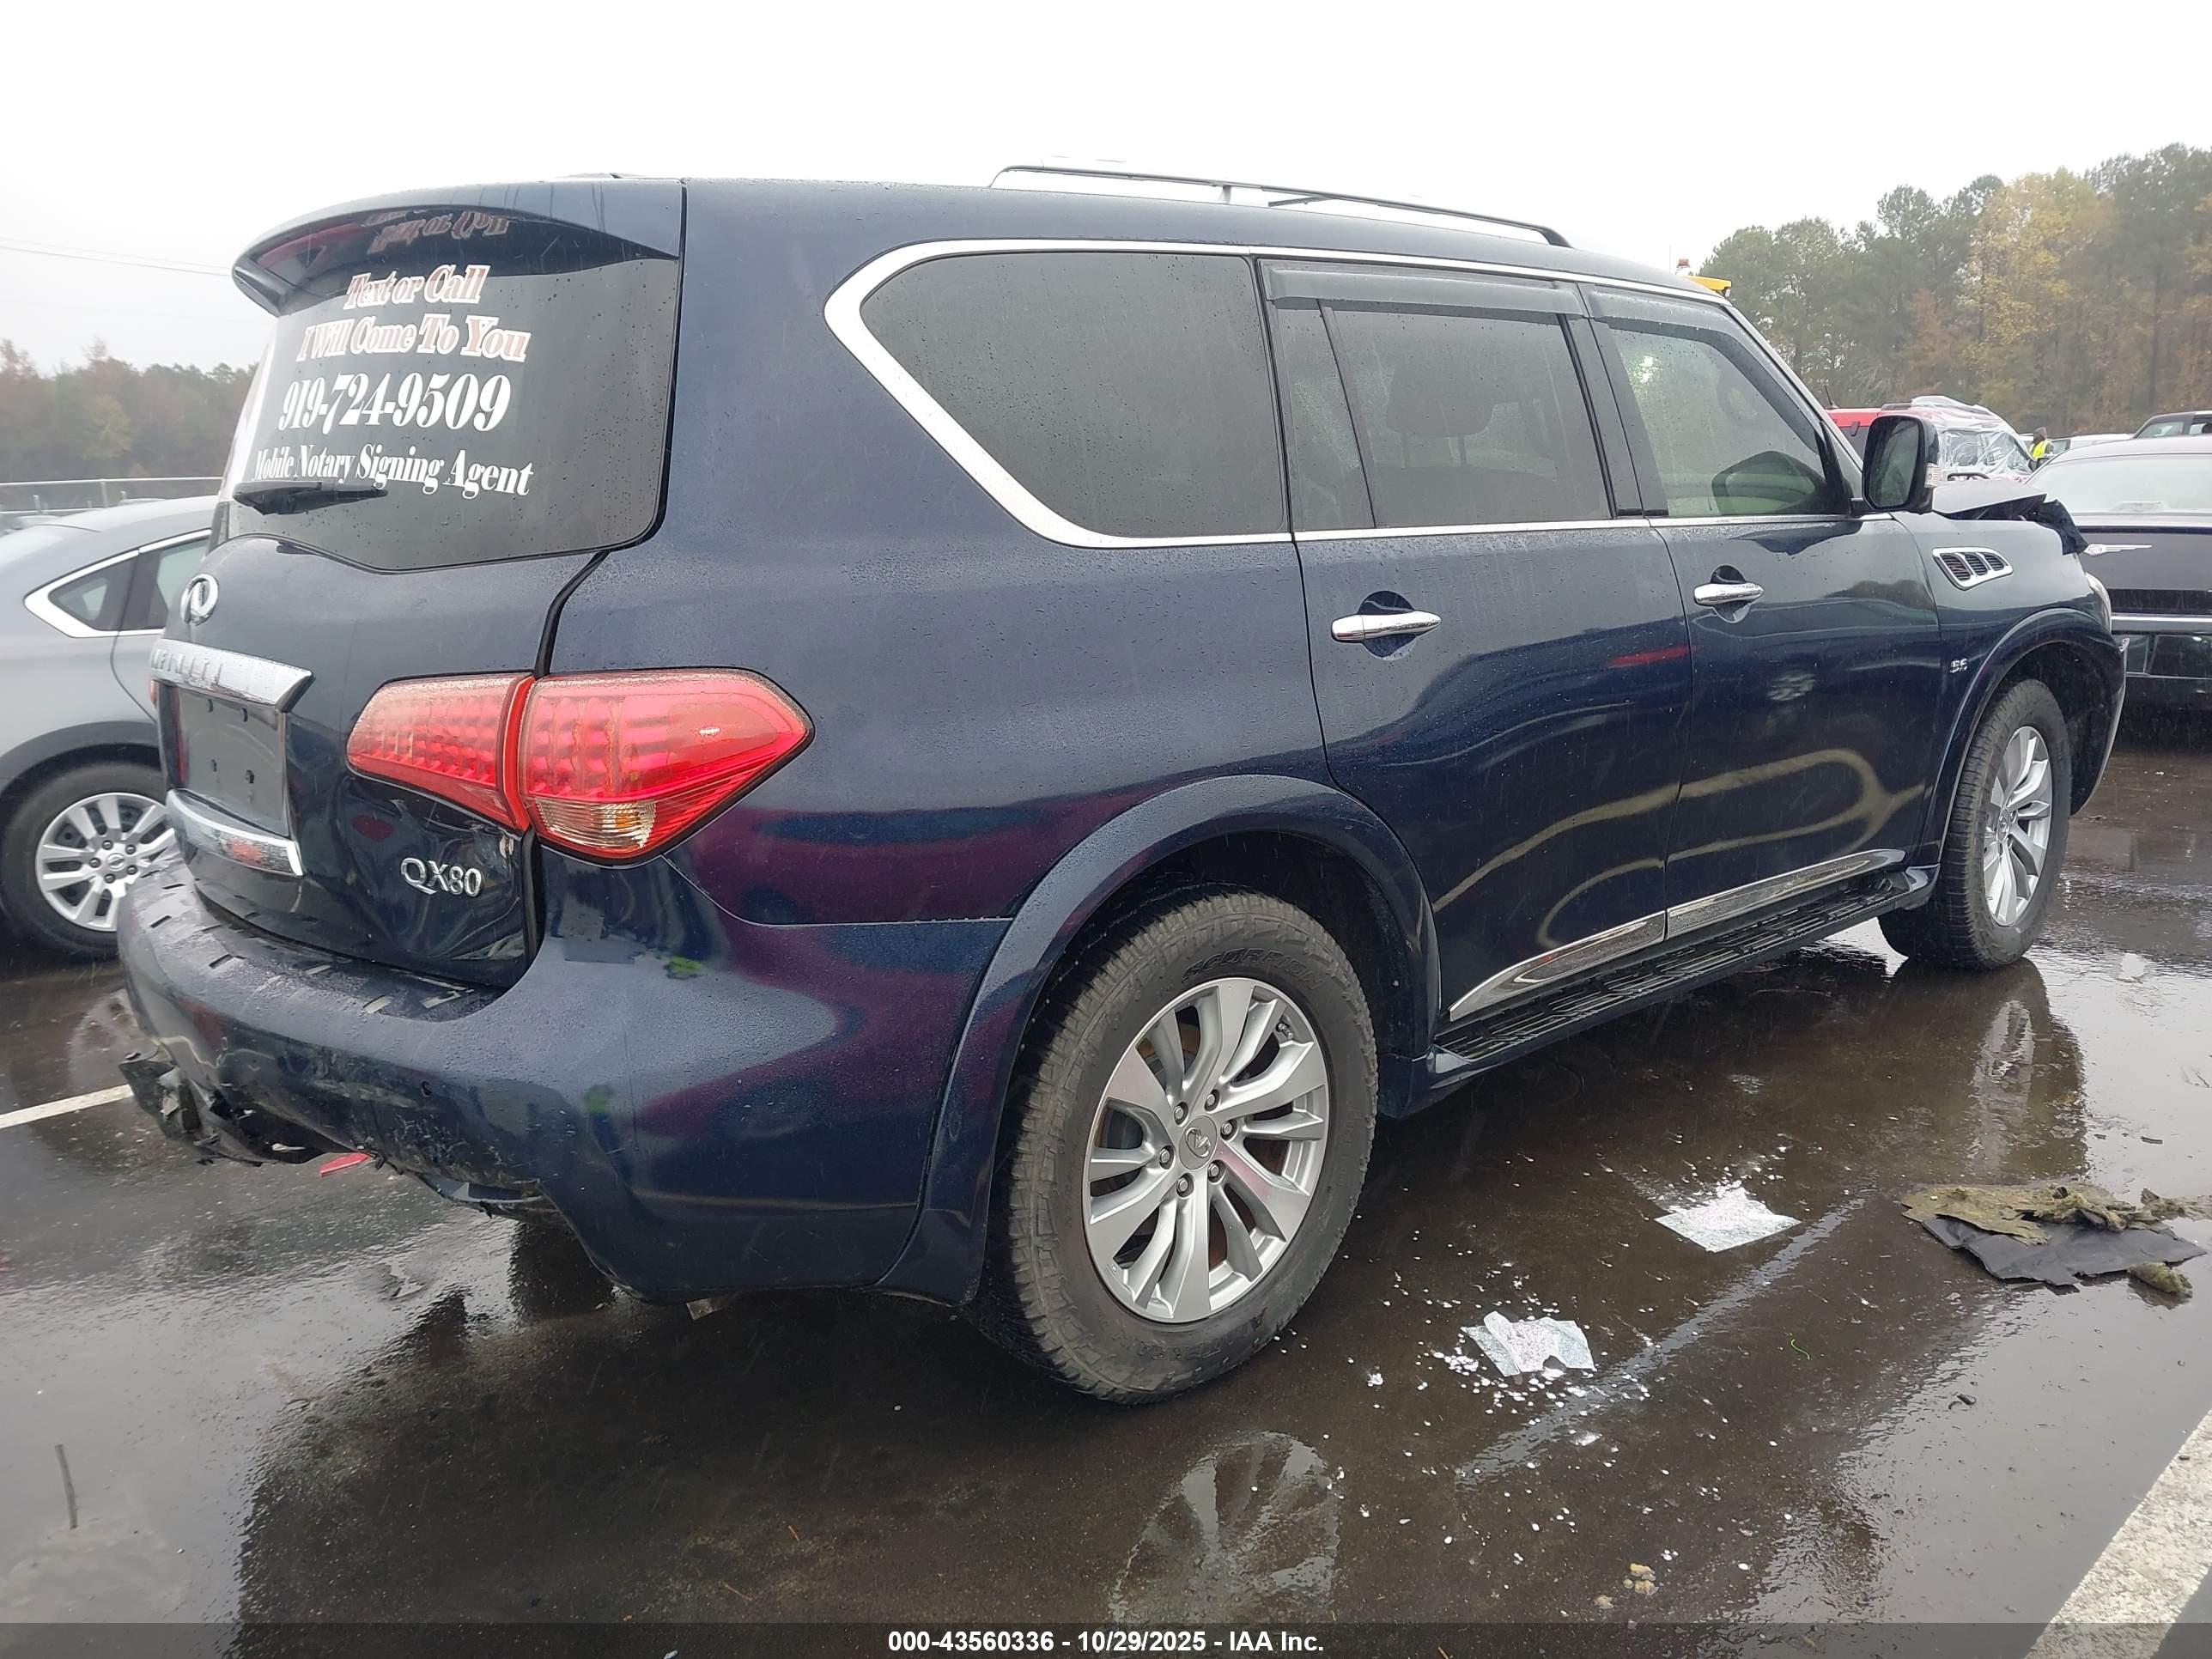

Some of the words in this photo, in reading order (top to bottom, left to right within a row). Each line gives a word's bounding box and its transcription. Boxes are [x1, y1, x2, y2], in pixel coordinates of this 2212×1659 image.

[343, 271, 397, 310] Text
[392, 276, 424, 304] or
[424, 264, 490, 304] Call
[295, 326, 316, 362] I
[310, 319, 355, 359] Will
[350, 316, 417, 355] Come
[416, 313, 459, 355] To
[460, 315, 532, 362] You
[278, 372, 511, 434] 919-724-9509
[252, 446, 294, 481] Mobile
[293, 444, 356, 483] Notary
[356, 444, 445, 495] Signing
[442, 449, 534, 500] Agent
[400, 857, 482, 897] QX80
